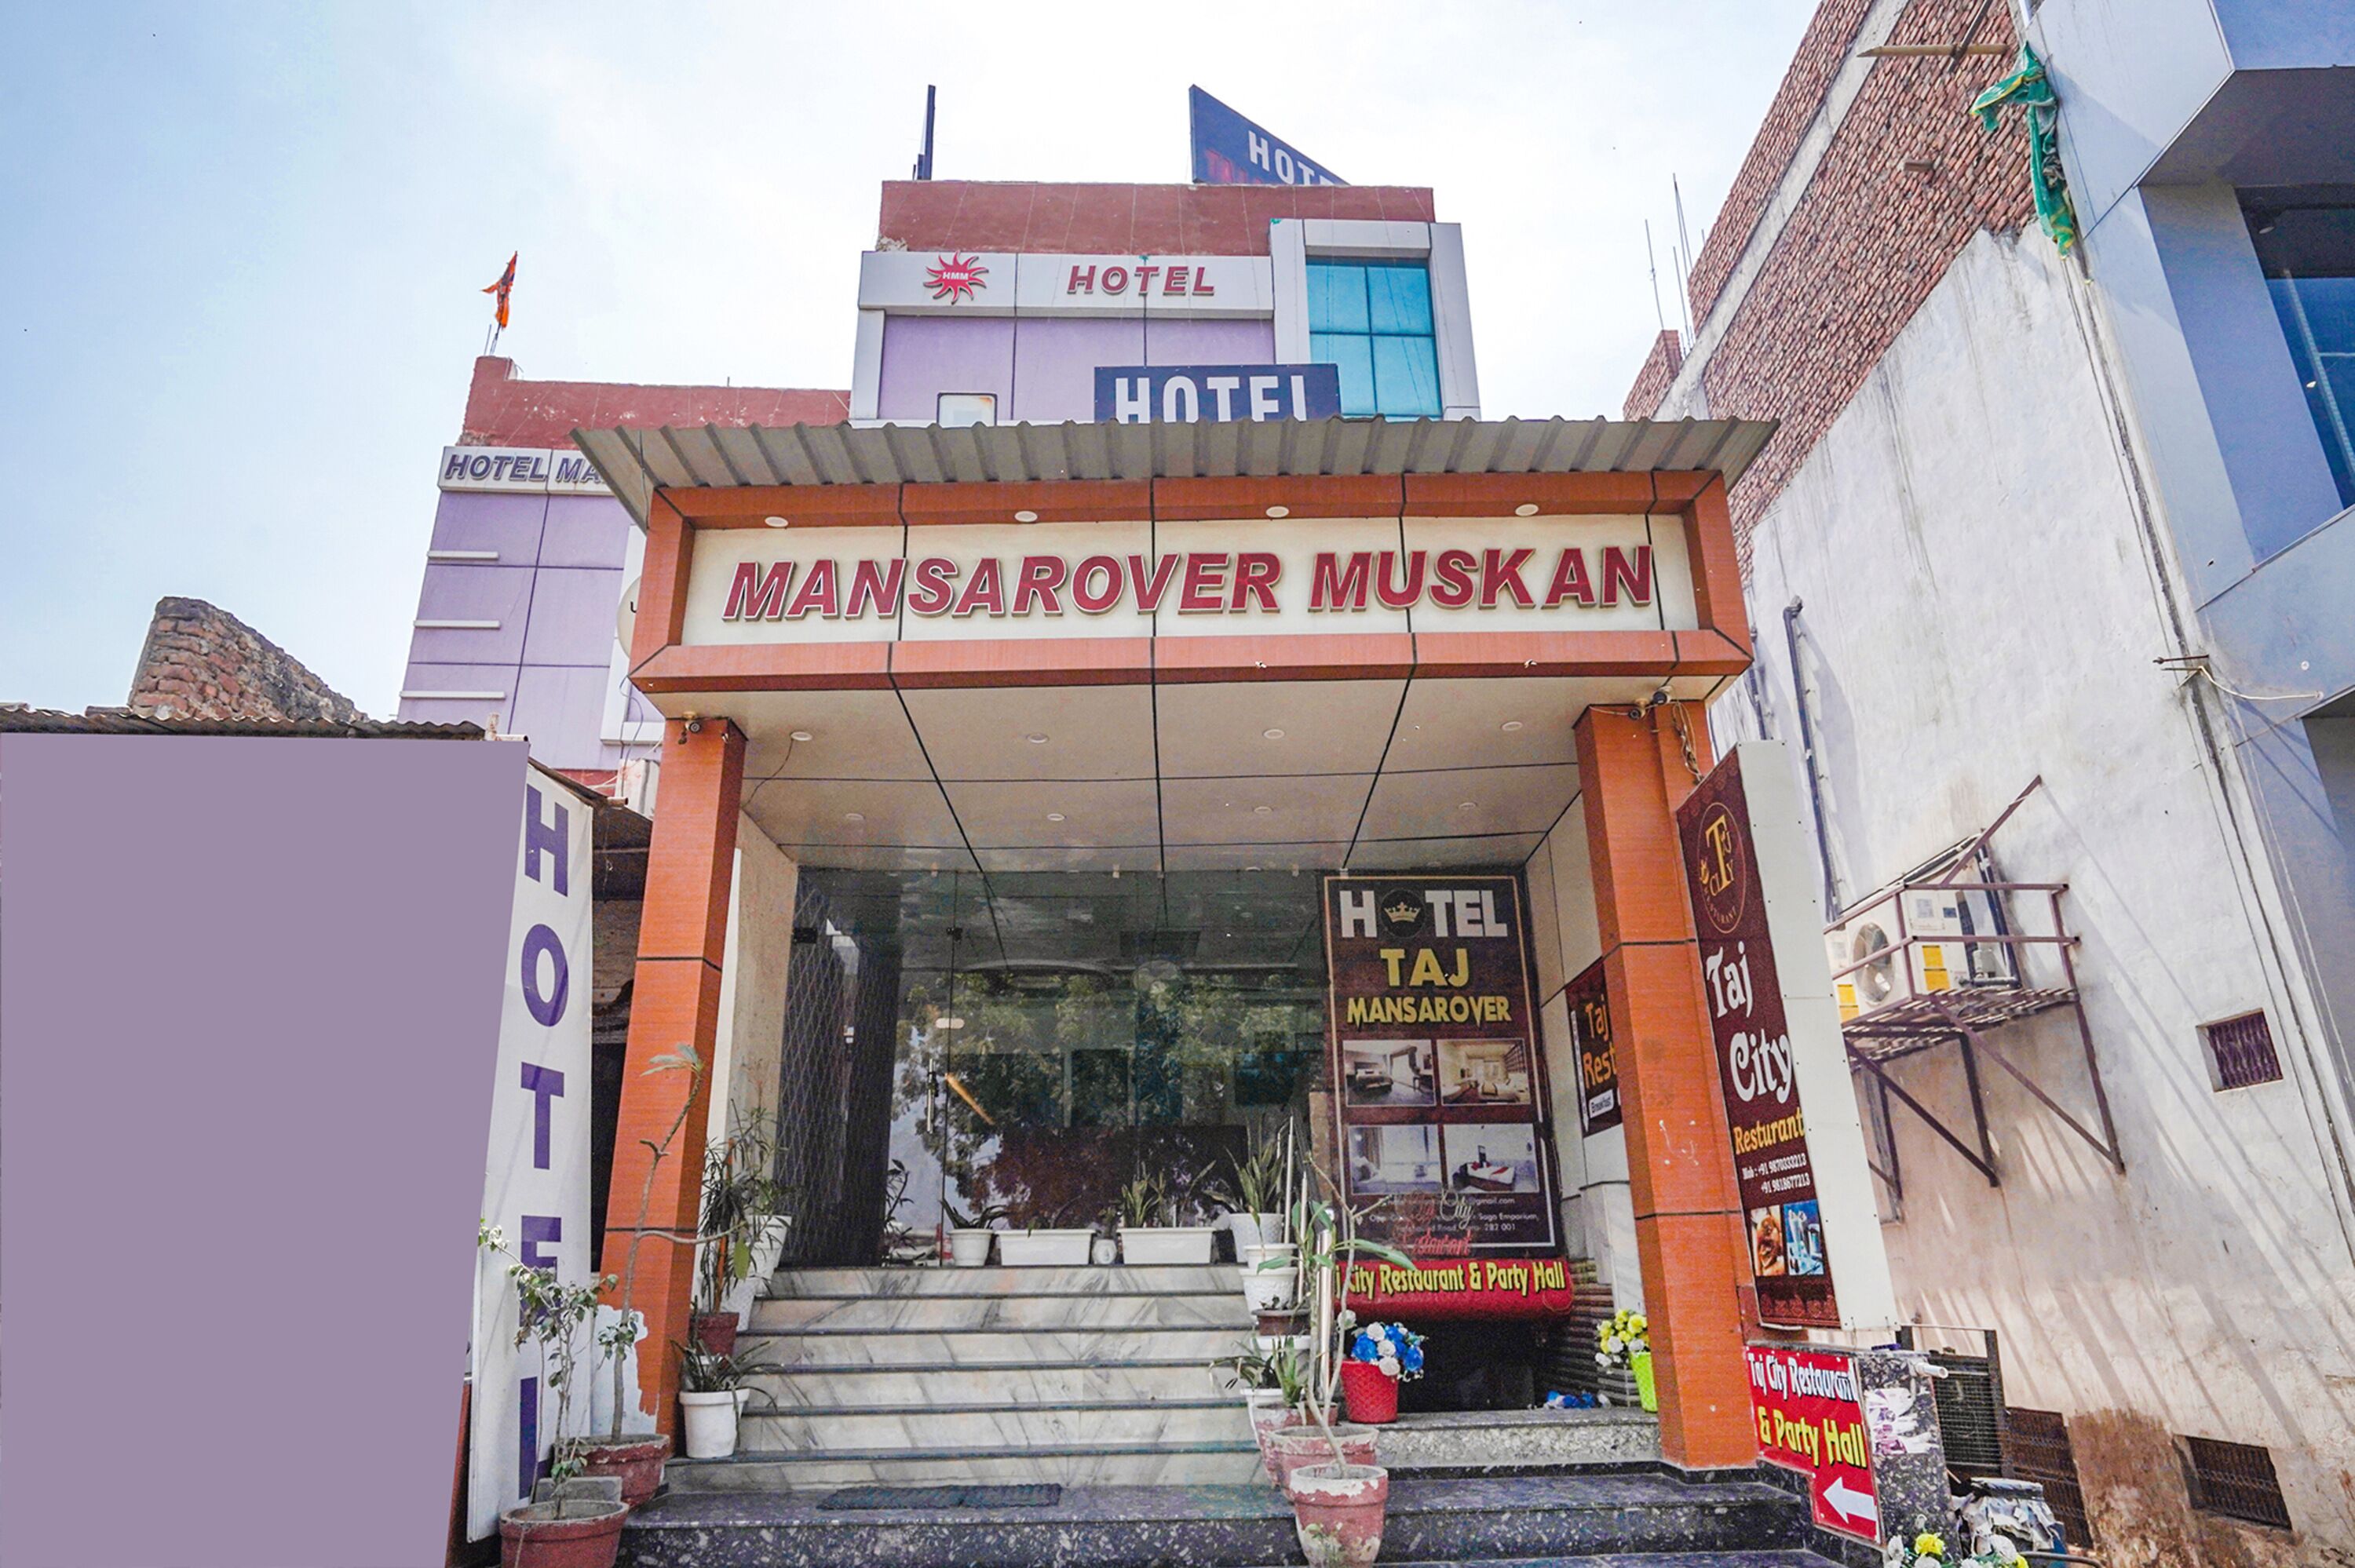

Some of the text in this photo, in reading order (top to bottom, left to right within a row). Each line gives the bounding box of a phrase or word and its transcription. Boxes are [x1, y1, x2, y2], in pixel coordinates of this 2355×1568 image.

[1248, 129, 1334, 185] HOT
[942, 271, 969, 281] HMM
[1067, 264, 1215, 296] HOTEL
[444, 454, 548, 482] HOTEL
[722, 545, 1652, 622] MANSAROVER MUSKAN
[1380, 948, 1470, 987] TAJ
[1706, 941, 1753, 1018] Taj
[1347, 996, 1512, 1027] MANSAROVER
[1585, 994, 1609, 1042] Taj
[1729, 1028, 1793, 1104] City
[519, 783, 569, 1501] HOTEL
[1733, 1107, 1805, 1154] Resturant
[1379, 1264, 1465, 1296] Restaurant
[1469, 1263, 1481, 1290] &
[1486, 1262, 1528, 1296] Party
[1532, 1261, 1566, 1293] Hall
[1747, 1352, 1859, 1402] Taj City Restaurant
[1758, 1406, 1868, 1469] & Party Hall
